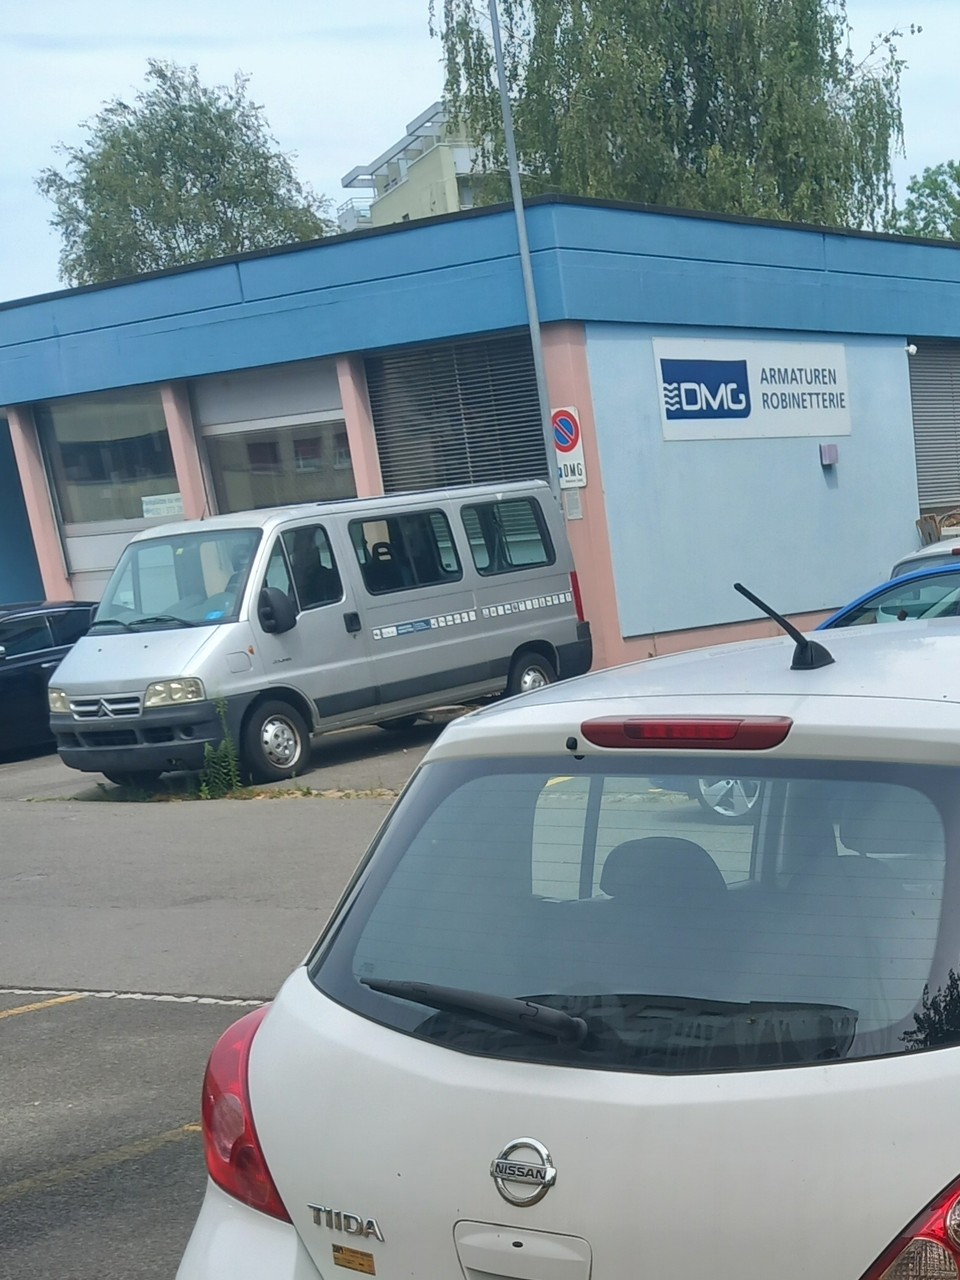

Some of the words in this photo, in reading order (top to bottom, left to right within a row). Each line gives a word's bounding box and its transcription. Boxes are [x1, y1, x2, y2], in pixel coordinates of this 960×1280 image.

[760, 367, 837, 386] ARMATUREN
[680, 382, 746, 411] DMG
[762, 392, 846, 410] ROBINETTERIE
[564, 462, 583, 478] DMG
[494, 1162, 547, 1181] NISSAN
[307, 1202, 386, 1243] TIIDA
